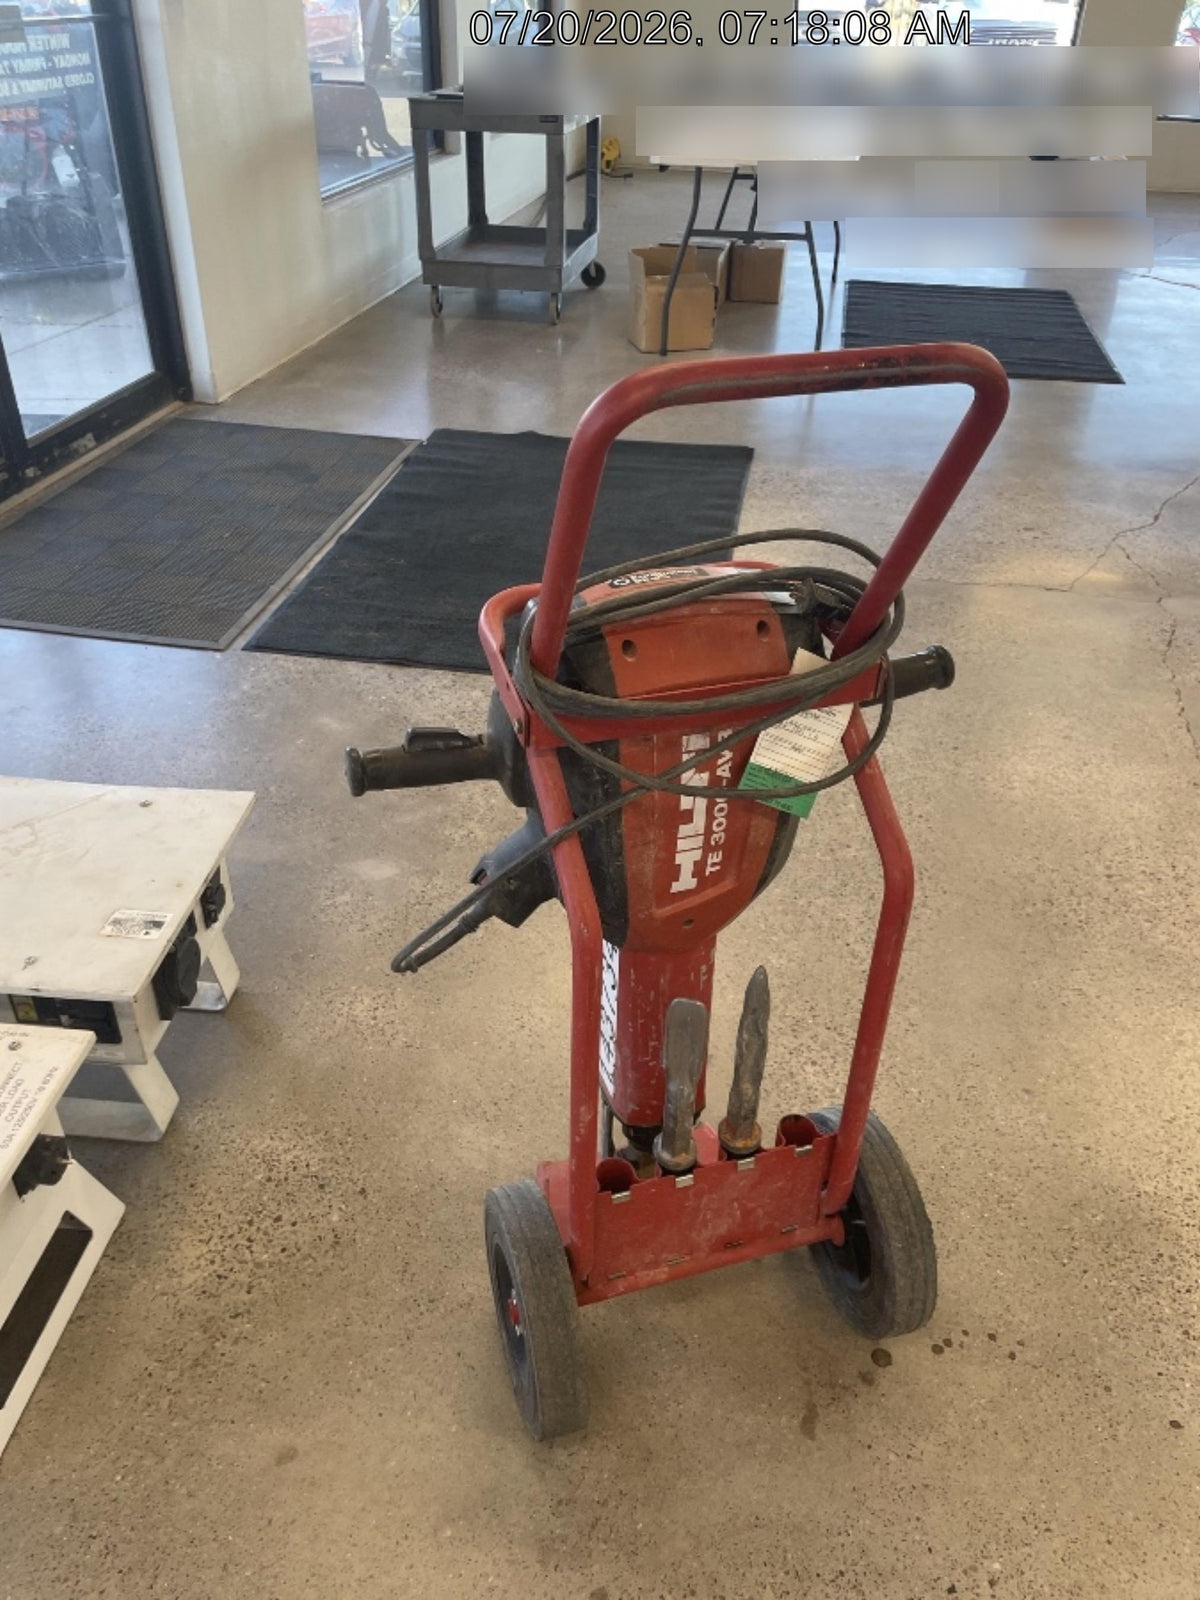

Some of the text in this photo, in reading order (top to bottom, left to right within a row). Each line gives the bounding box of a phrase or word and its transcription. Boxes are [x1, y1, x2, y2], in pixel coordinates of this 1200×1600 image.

[670, 732, 710, 893] HILTI
[705, 849, 722, 877] TE
[5, 1089, 30, 1122] OUTPUT
